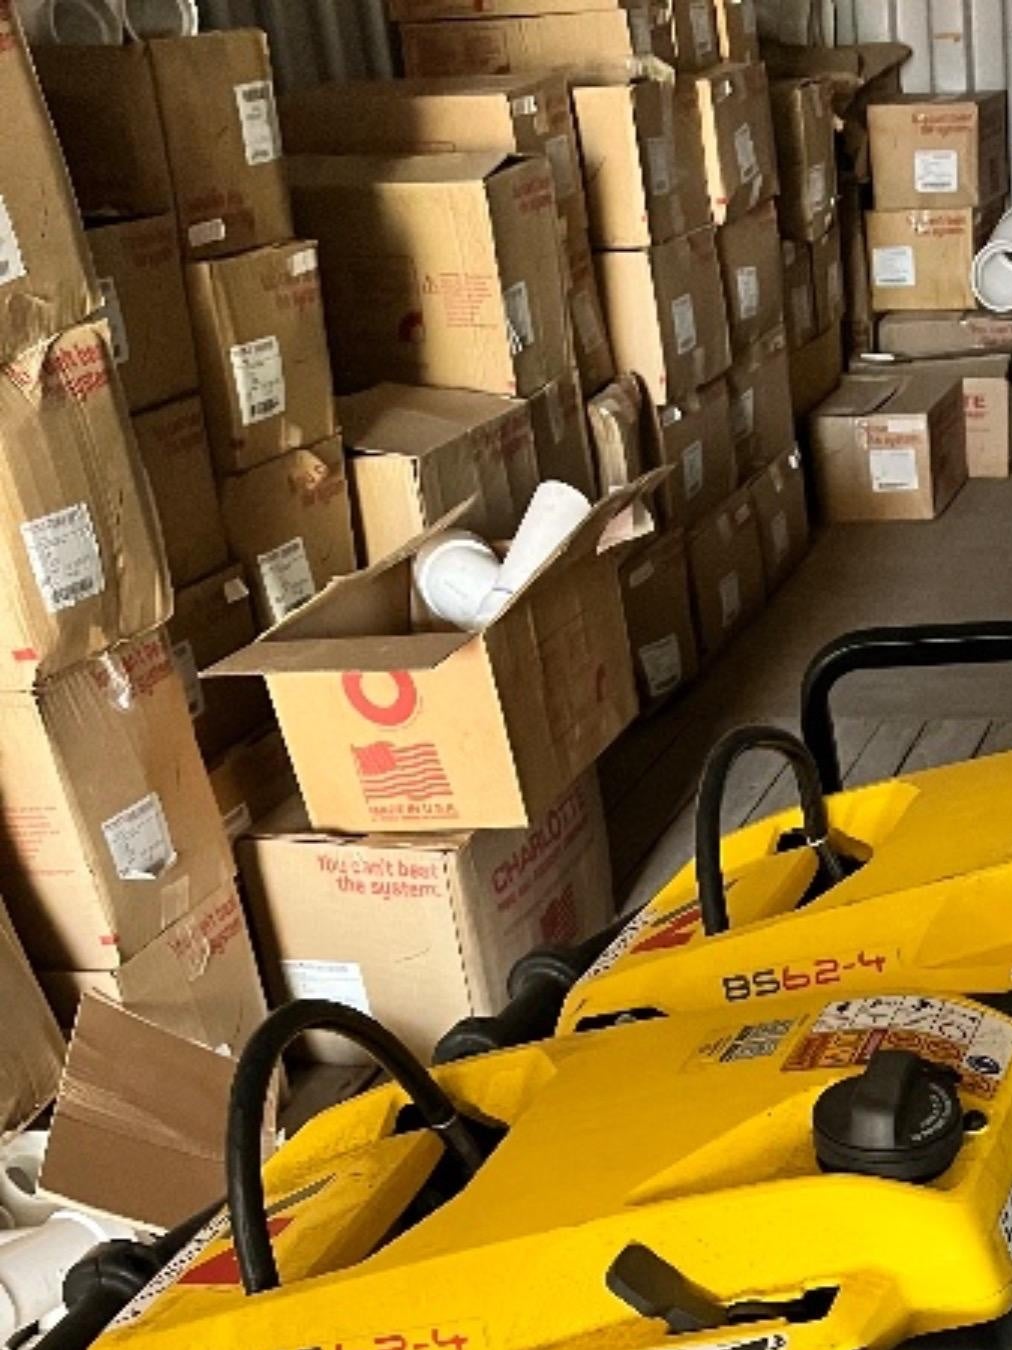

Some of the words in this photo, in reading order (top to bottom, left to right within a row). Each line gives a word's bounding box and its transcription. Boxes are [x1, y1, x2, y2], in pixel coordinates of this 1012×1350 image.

[317, 855, 347, 874] You
[351, 857, 394, 876] can't
[397, 858, 438, 880] beat
[336, 875, 366, 895] the
[371, 877, 442, 900] system.
[722, 952, 886, 1002] BS62-4
